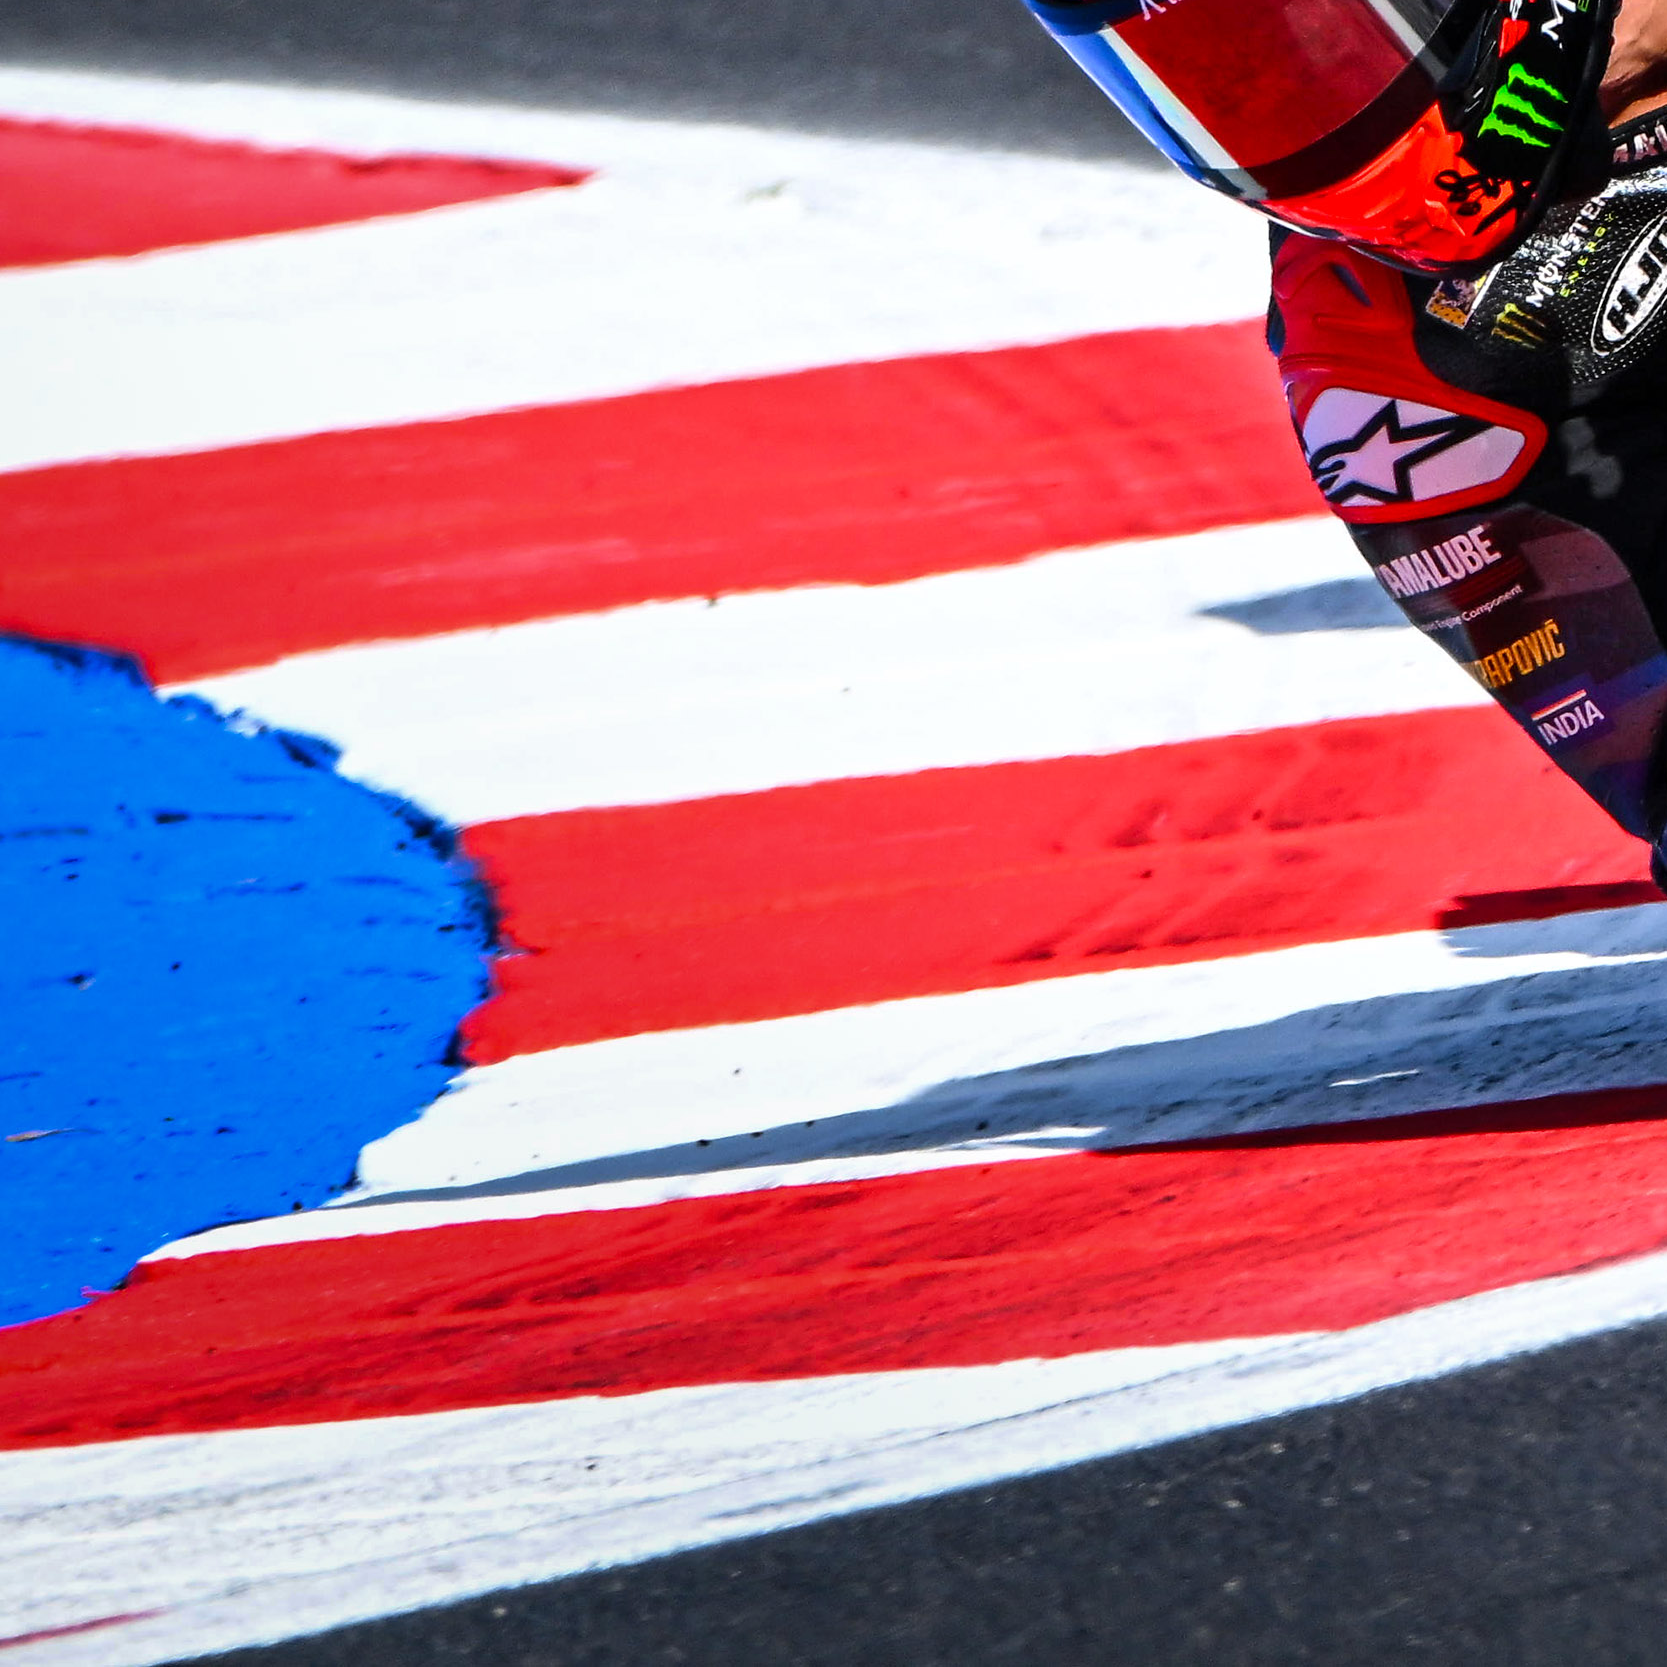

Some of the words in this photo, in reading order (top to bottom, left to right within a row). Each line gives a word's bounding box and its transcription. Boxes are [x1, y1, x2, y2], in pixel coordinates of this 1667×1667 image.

[1525, 184, 1616, 308] MONSTER
[1461, 584, 1524, 622] Component
[1537, 699, 1605, 746] INDIA
